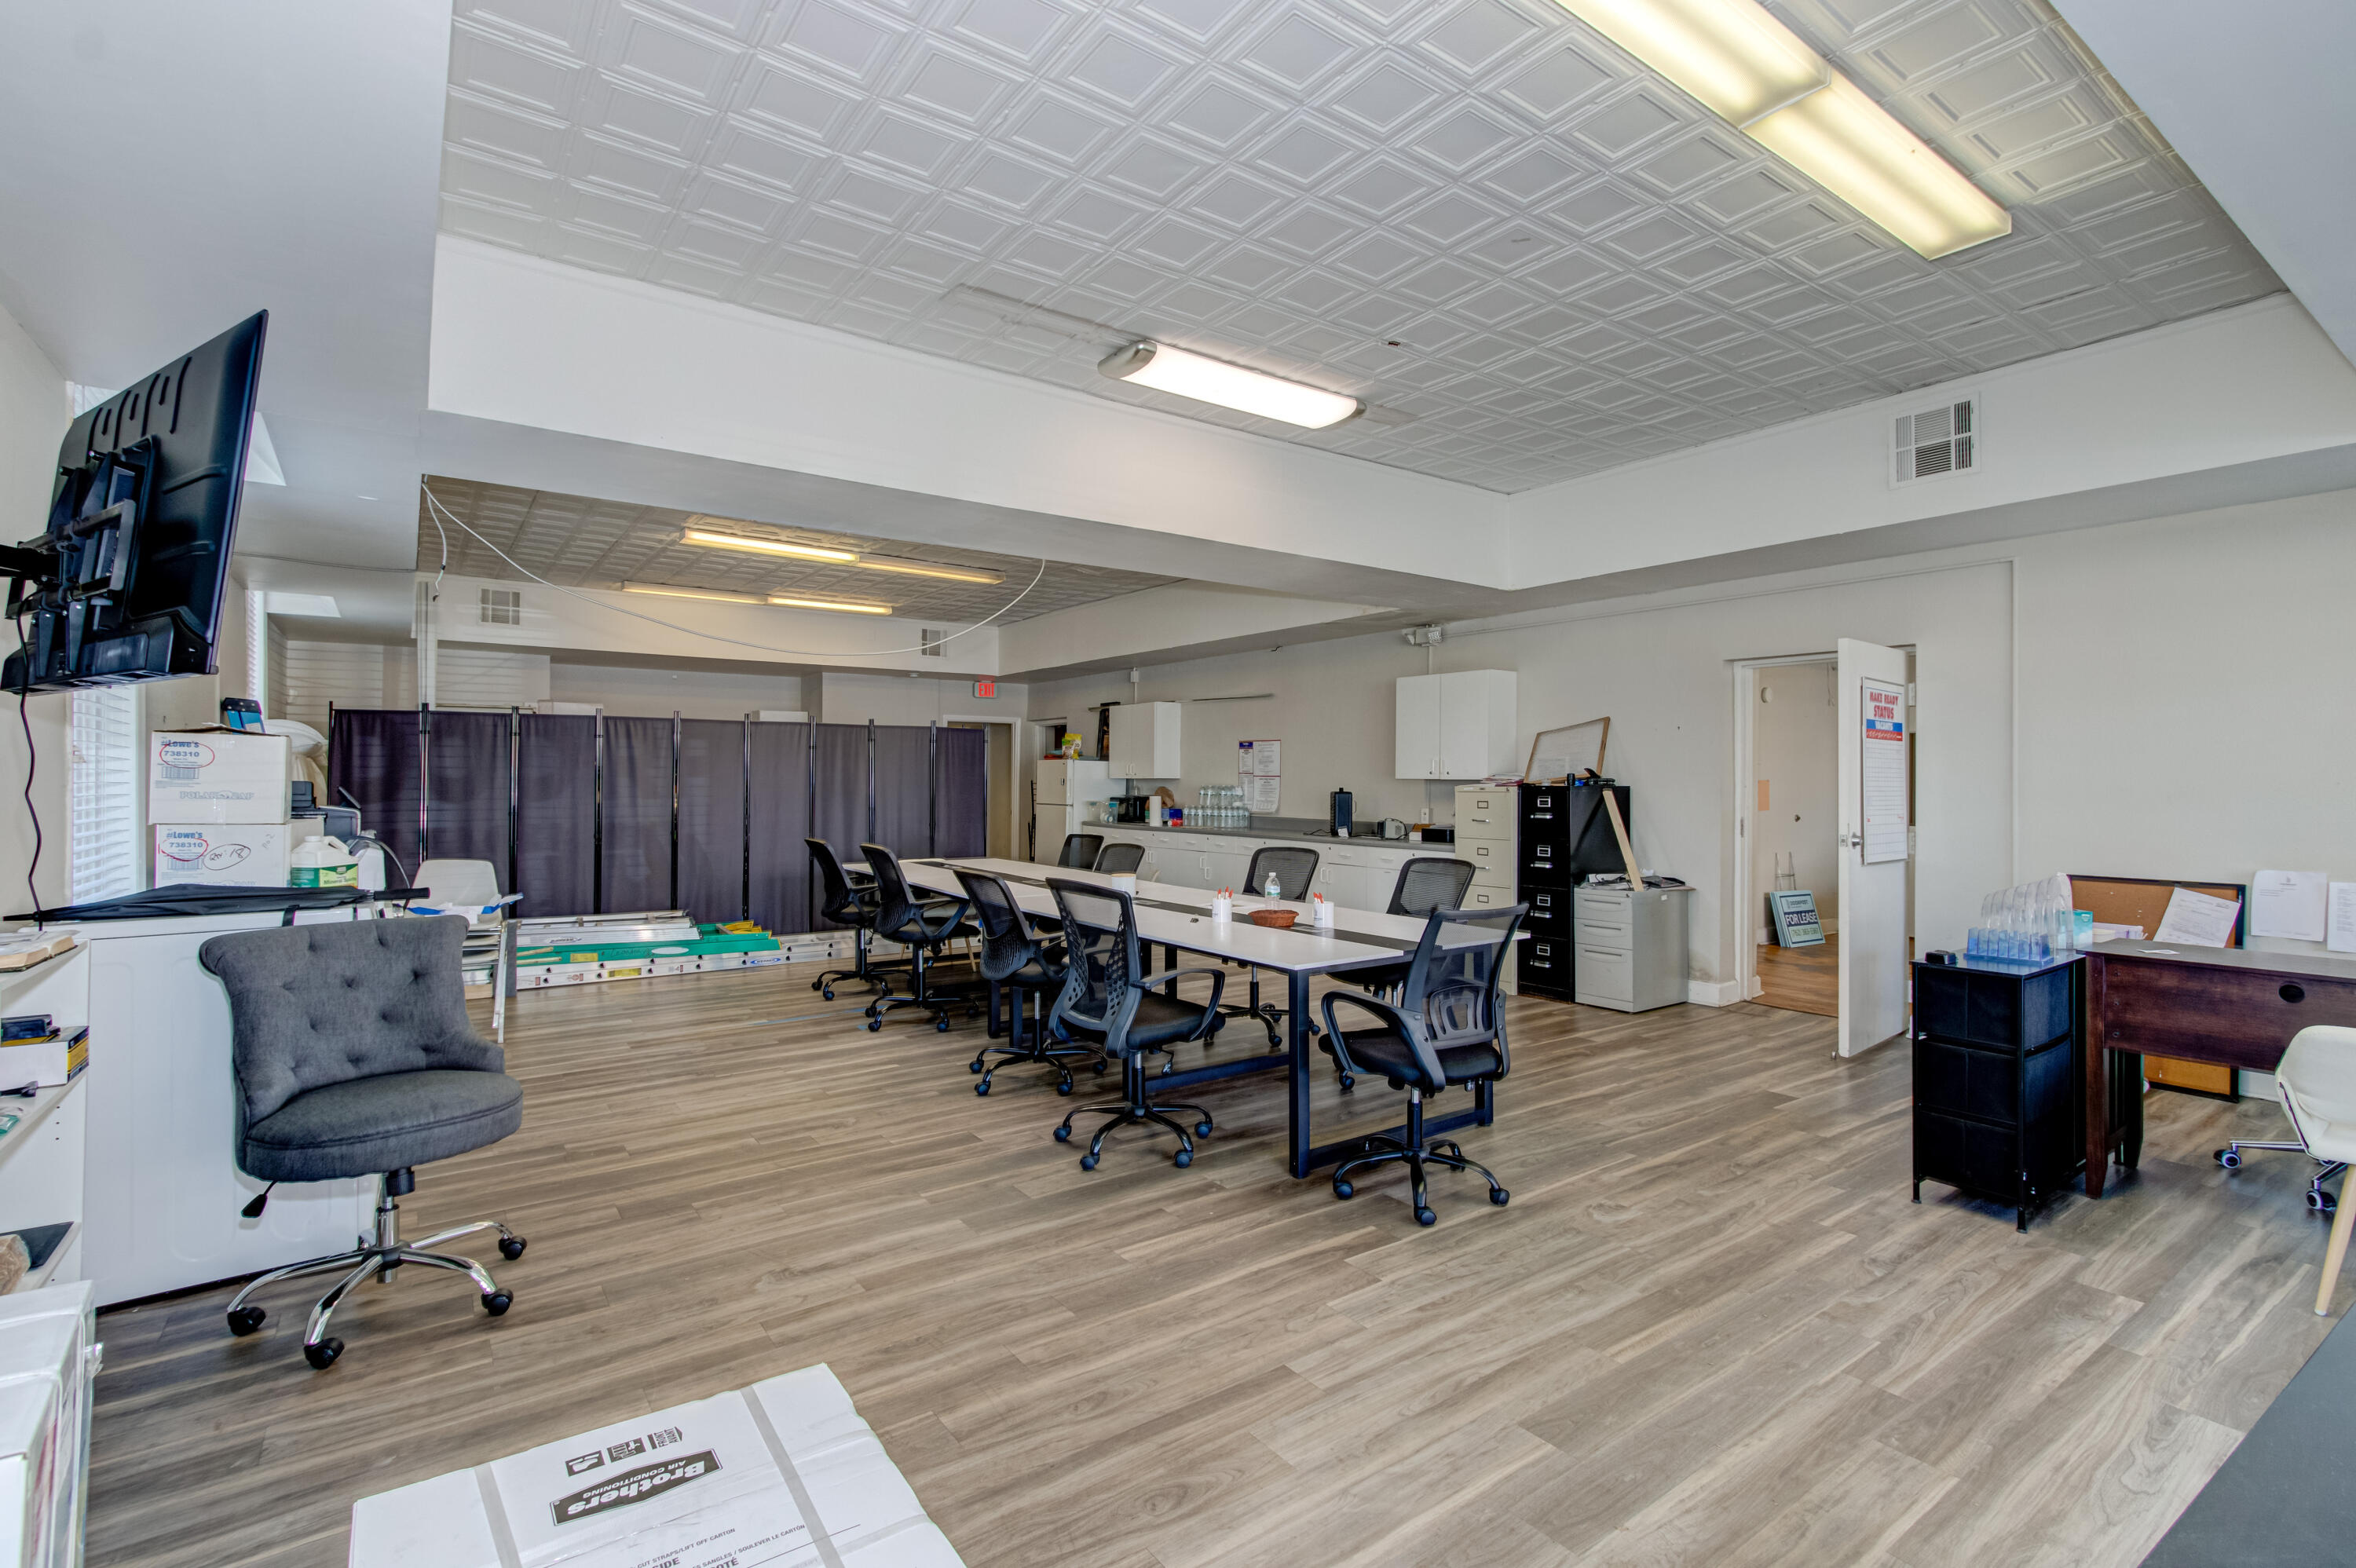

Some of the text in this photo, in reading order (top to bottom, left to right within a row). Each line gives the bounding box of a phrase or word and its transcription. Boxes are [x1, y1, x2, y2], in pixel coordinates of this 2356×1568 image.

[979, 683, 995, 697] EXIT
[1870, 691, 1899, 706] MAKE READY
[1874, 704, 1894, 719] STATUS
[1785, 912, 1817, 925] FOR LEASE
[653, 1431, 668, 1447] FRONT
[664, 1428, 679, 1443] AVANT
[583, 1460, 686, 1499] AIR CONDITIONING
[567, 1460, 705, 1515] Brothers
[653, 1544, 694, 1563] STRAPS/LIFT
[710, 1528, 736, 1541] CARTON
[702, 1552, 733, 1567] SANGLES
[737, 1537, 771, 1553] SOULEVER
[781, 1524, 806, 1537] CARTON
